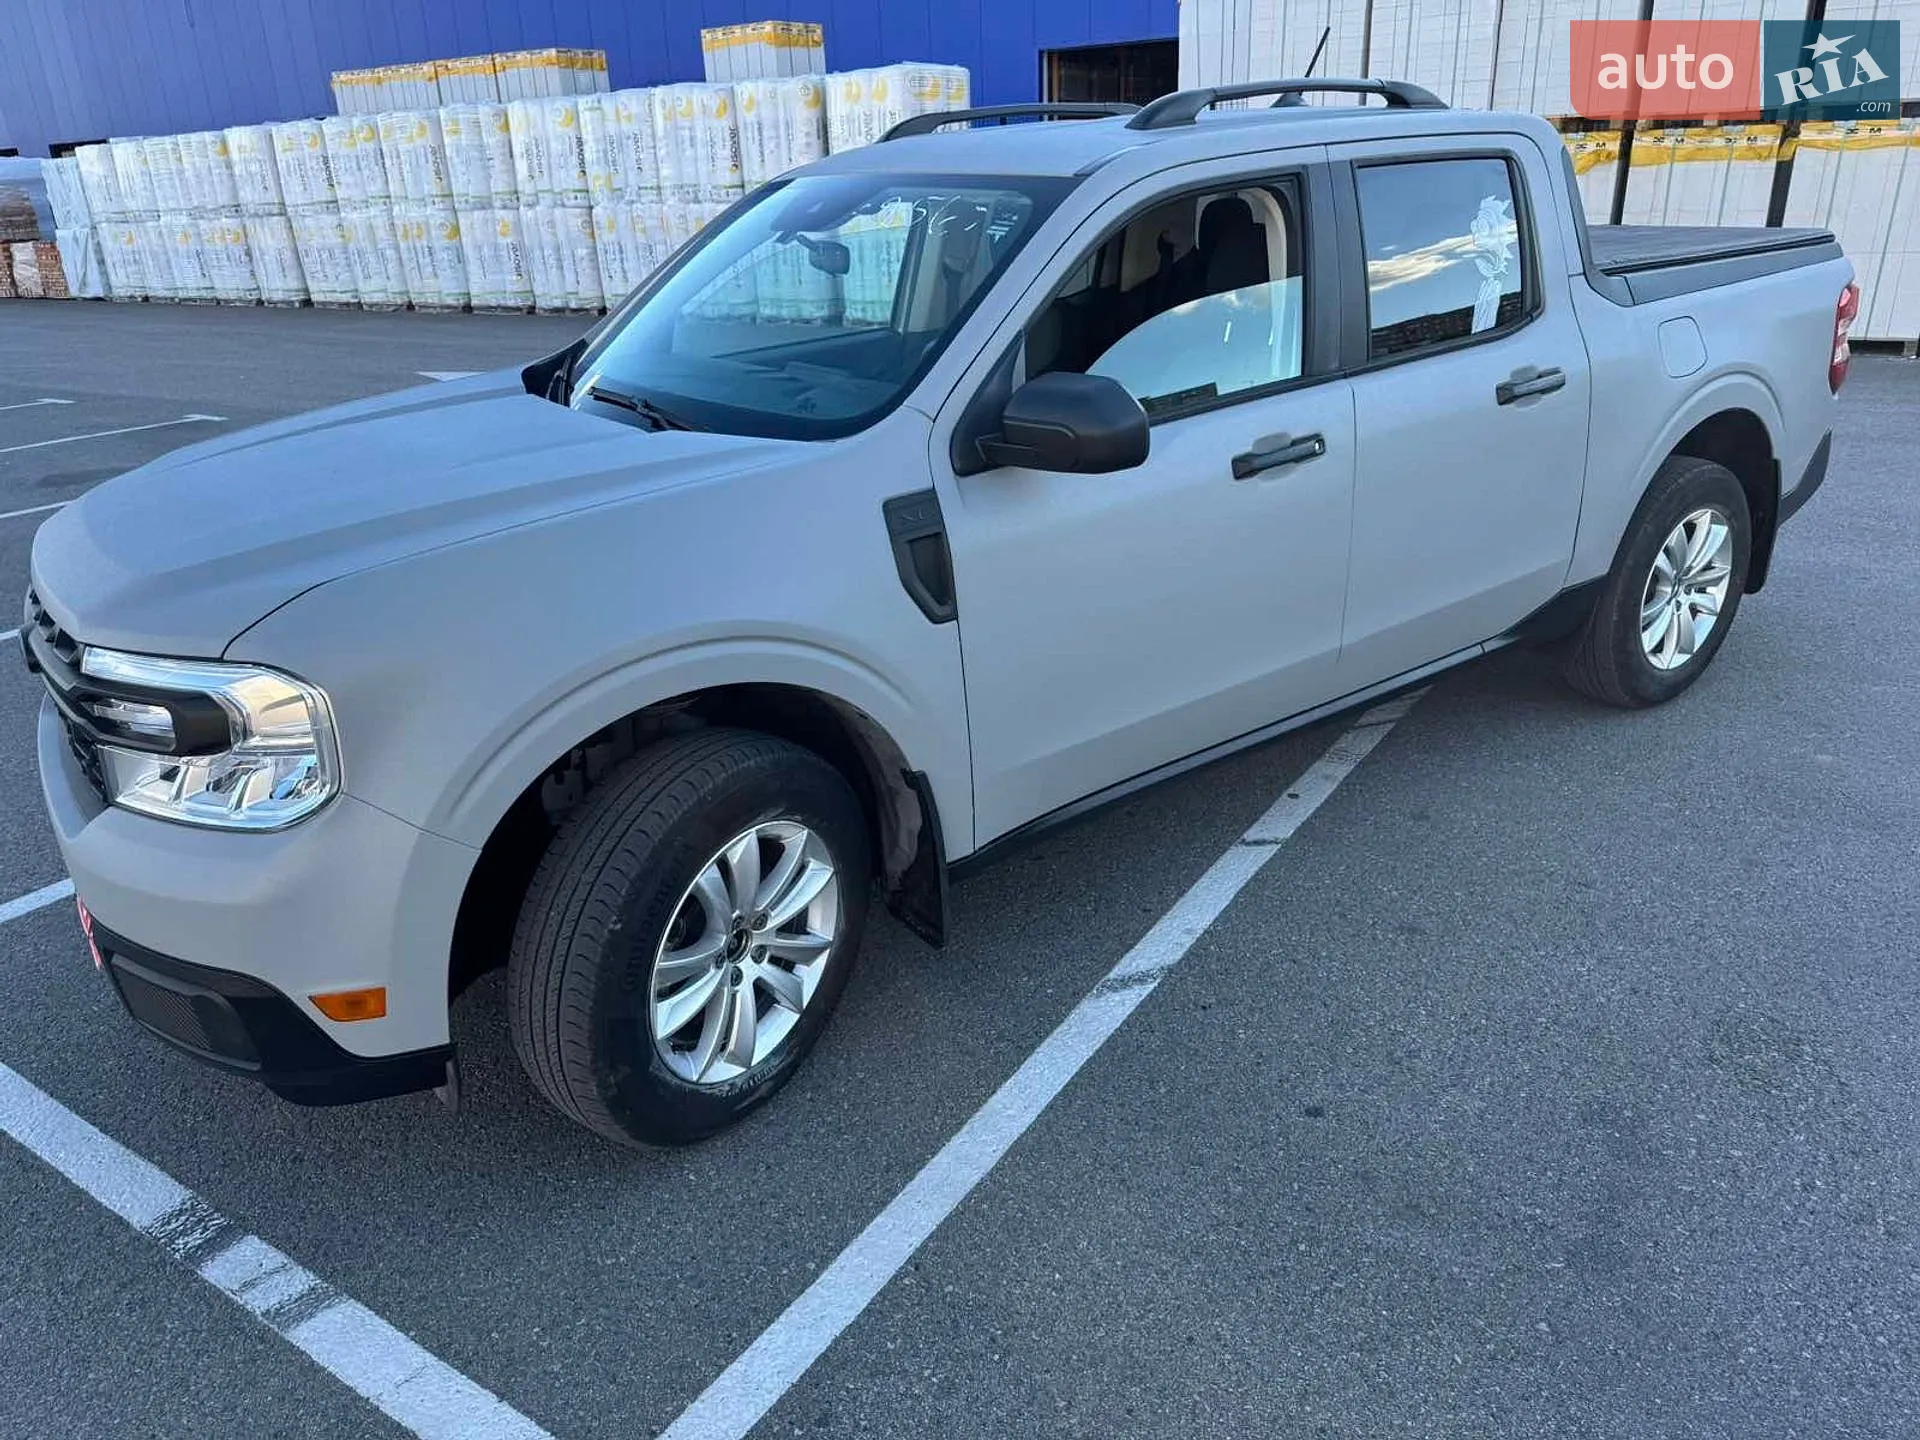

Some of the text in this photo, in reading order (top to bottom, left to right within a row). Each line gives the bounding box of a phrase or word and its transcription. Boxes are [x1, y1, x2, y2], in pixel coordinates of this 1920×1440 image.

[575, 134, 586, 170] isover
[729, 126, 738, 164] isover
[510, 241, 521, 273] isover
